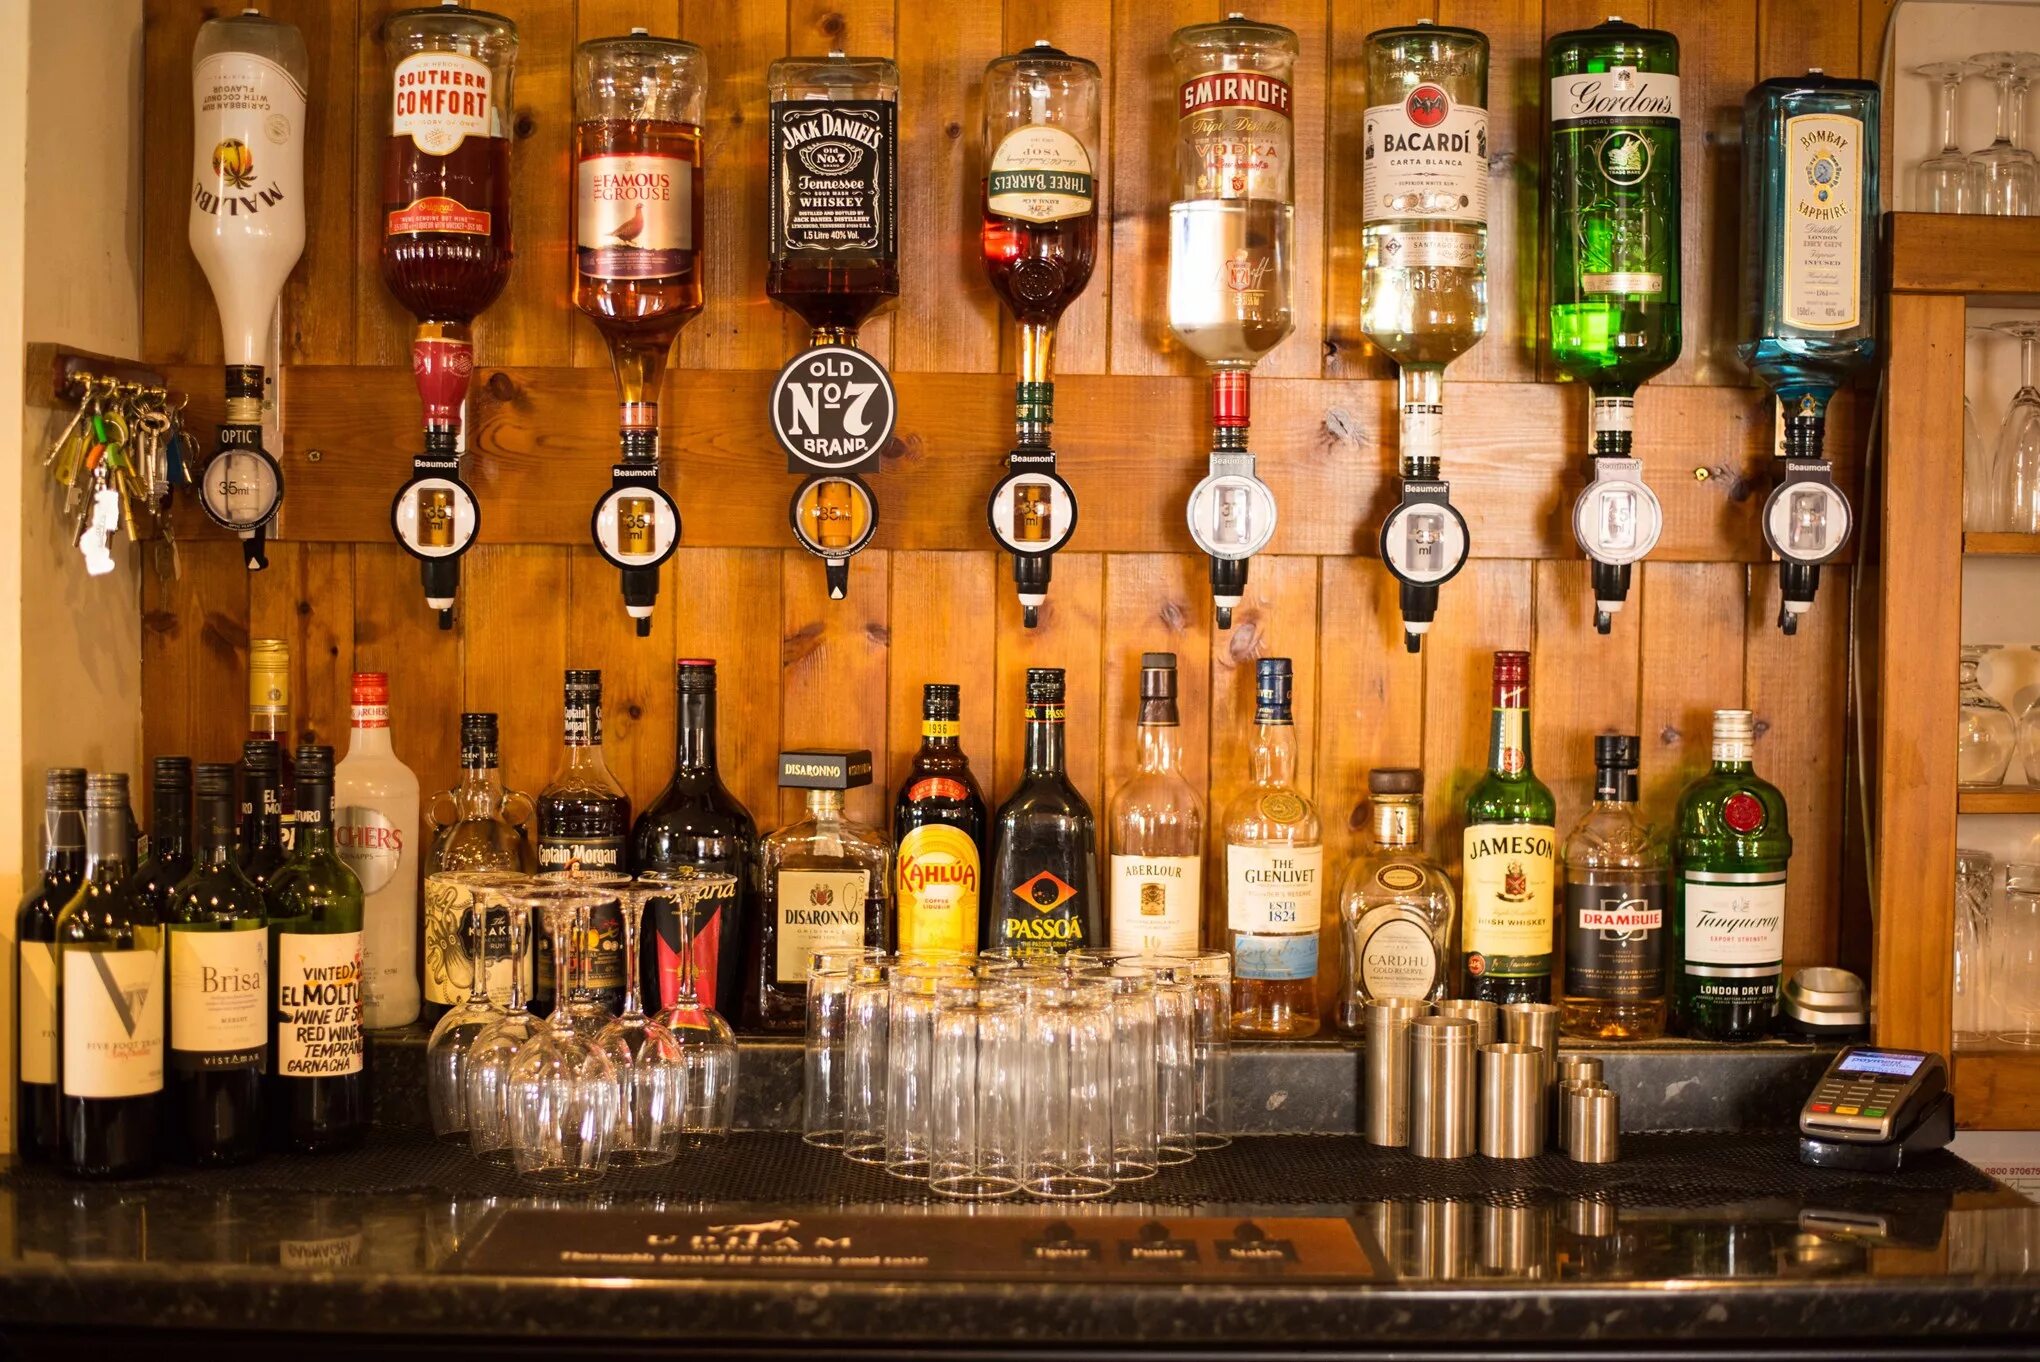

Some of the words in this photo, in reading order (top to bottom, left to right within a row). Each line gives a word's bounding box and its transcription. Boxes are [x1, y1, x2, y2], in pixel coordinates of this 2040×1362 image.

[399, 70, 486, 90] SOUTHERN
[213, 86, 255, 94] FLAVOUR
[1185, 78, 1288, 110] SMIRNOFF
[1570, 80, 1672, 115] Gordon's
[204, 94, 242, 104] COCONUT
[244, 94, 268, 104] WITH
[397, 89, 488, 118] COMFORT
[217, 102, 270, 112] CARIBBEAN
[782, 120, 822, 150] JACK
[822, 114, 884, 150] DANIEL'S
[1192, 118, 1228, 137] Triple
[1384, 130, 1470, 154] BACARDÍ
[1800, 130, 1848, 151] BOMBAY
[1195, 143, 1278, 158] VODKA
[603, 174, 670, 188] FAMOUS
[798, 176, 864, 190] Tennessee
[994, 174, 1047, 190] BARRELS
[1050, 176, 1086, 194] THREE
[594, 176, 602, 202] THE
[602, 188, 670, 201] GROUSE
[193, 181, 285, 216] MALIBU
[800, 198, 864, 208] WHISKEY
[1798, 201, 1848, 220] SAPPHIRE
[814, 231, 830, 240] Litre
[830, 231, 847, 240] 40%
[847, 231, 860, 240] Vol.
[1804, 223, 1842, 234] Distilled
[1414, 242, 1452, 250] SANTIAGO
[810, 358, 854, 377] OLD
[222, 429, 252, 444] OPTIC
[414, 459, 458, 469] Beaumont
[1011, 454, 1054, 464] Beaumont
[614, 468, 657, 478] Beaumont
[1789, 463, 1831, 472] Beaumont
[219, 481, 250, 496] 35ml
[1405, 485, 1448, 494] Beaumont
[426, 504, 446, 520] 35
[430, 520, 443, 530] ml
[626, 514, 646, 530] 35
[1025, 517, 1038, 526] ml
[629, 530, 642, 540] ml
[1418, 545, 1432, 556] ml
[358, 706, 388, 718] ARCHERS
[928, 724, 948, 734] 1936
[785, 763, 841, 778] DISARONNO
[336, 825, 403, 850] CHERS
[539, 844, 571, 866] Captain
[570, 844, 618, 867] Morgan
[1470, 837, 1554, 860] JAMESON
[1126, 865, 1182, 878] ABERLOUR
[1272, 859, 1294, 869] THE
[900, 855, 976, 893] KAHLÚA
[1245, 869, 1316, 884] GLENLIVET
[785, 910, 859, 927] DISARONNO
[1269, 911, 1296, 922] 1824
[1584, 911, 1660, 927] DRAMBUIE
[1696, 910, 1780, 933] Tanqueray
[1006, 915, 1083, 940] PASSOÃ
[1144, 935, 1161, 949] 10
[1369, 954, 1430, 968] CARDHU
[303, 966, 351, 982] VINTED
[1394, 967, 1424, 975] RESERVE
[201, 966, 261, 994] Brisa
[282, 986, 301, 1007] EL
[1700, 985, 1739, 996] LONDON
[1742, 986, 1760, 996] DRY
[1762, 985, 1774, 995] GIN
[221, 1016, 248, 1024] MERLOT
[294, 1009, 333, 1026] WINE
[335, 1006, 350, 1024] OF
[297, 1026, 326, 1044] RED
[329, 1025, 358, 1043] WINE
[287, 1058, 350, 1073] GARNACHA
[1852, 1058, 1902, 1066] payment
[1985, 1167, 2008, 1176] 0800
